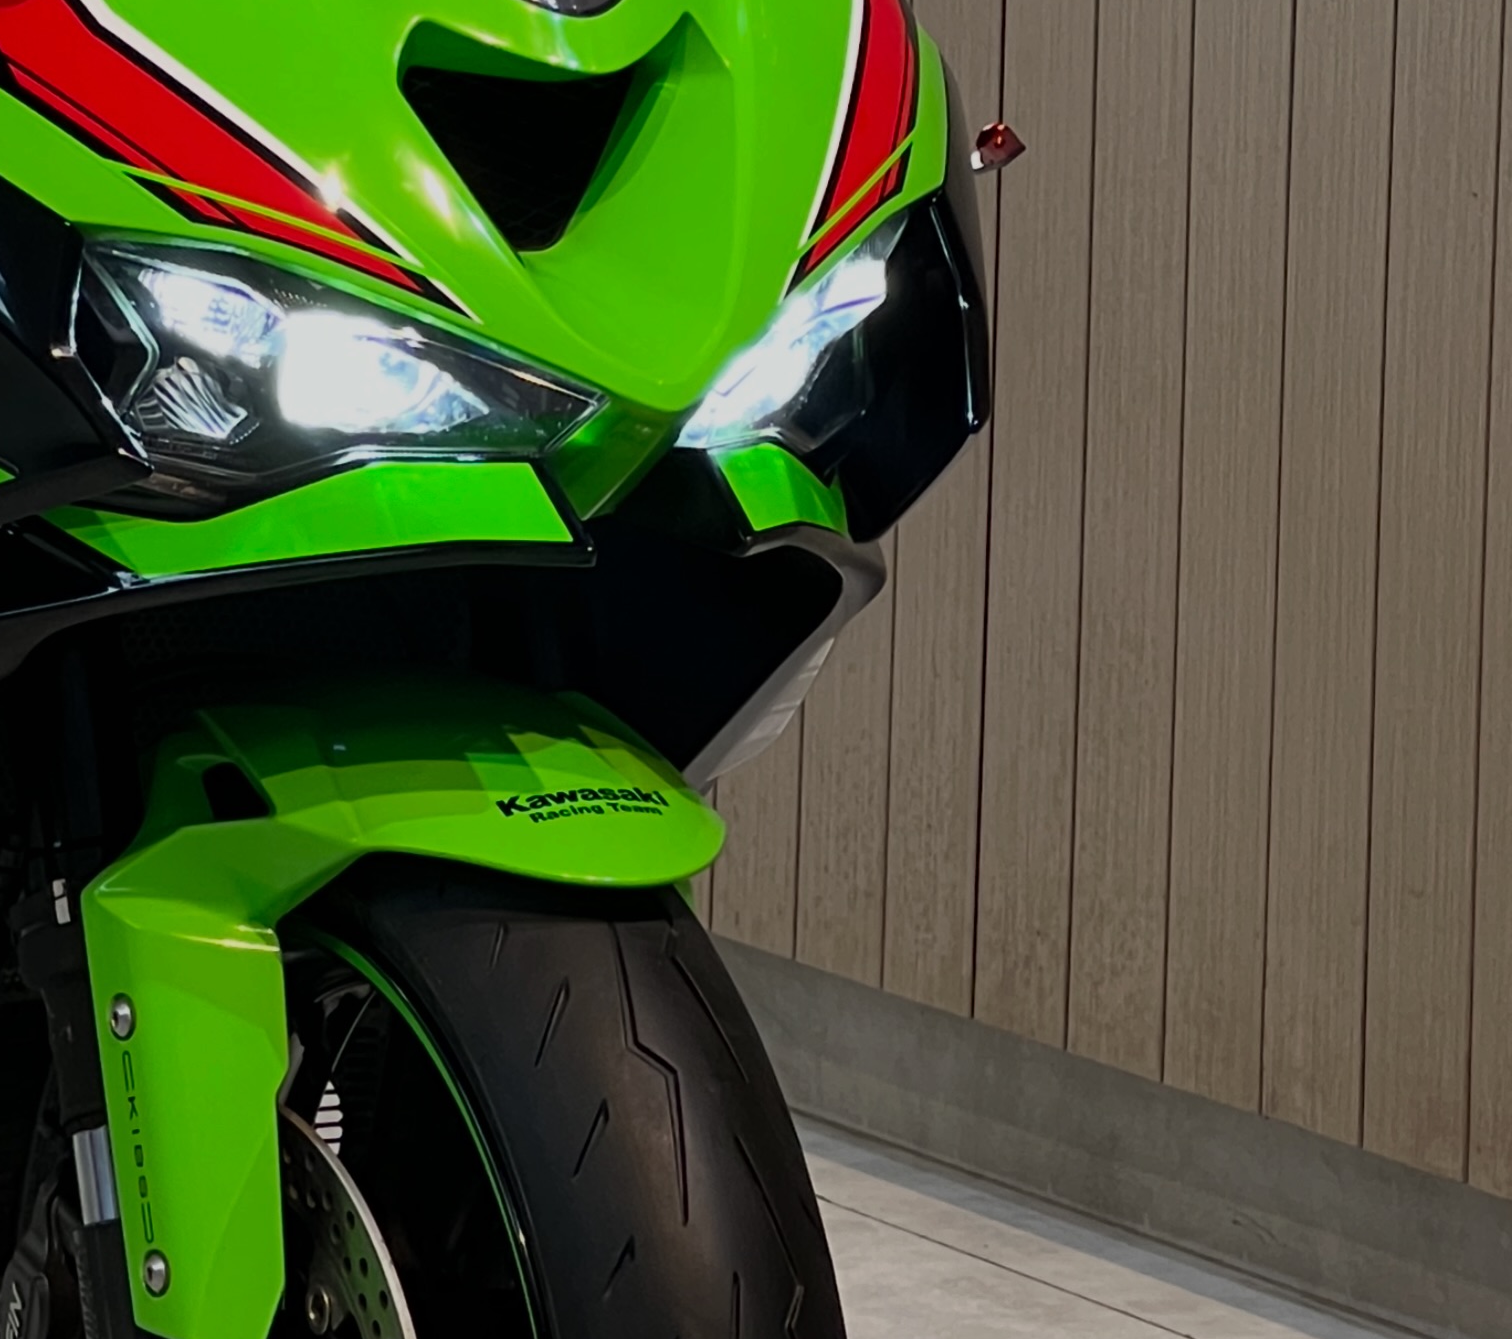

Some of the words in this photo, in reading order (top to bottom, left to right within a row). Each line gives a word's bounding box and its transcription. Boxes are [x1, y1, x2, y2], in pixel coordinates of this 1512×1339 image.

[495, 787, 670, 818] Kawasaki
[529, 804, 605, 823] Racing
[605, 801, 664, 816] Team
